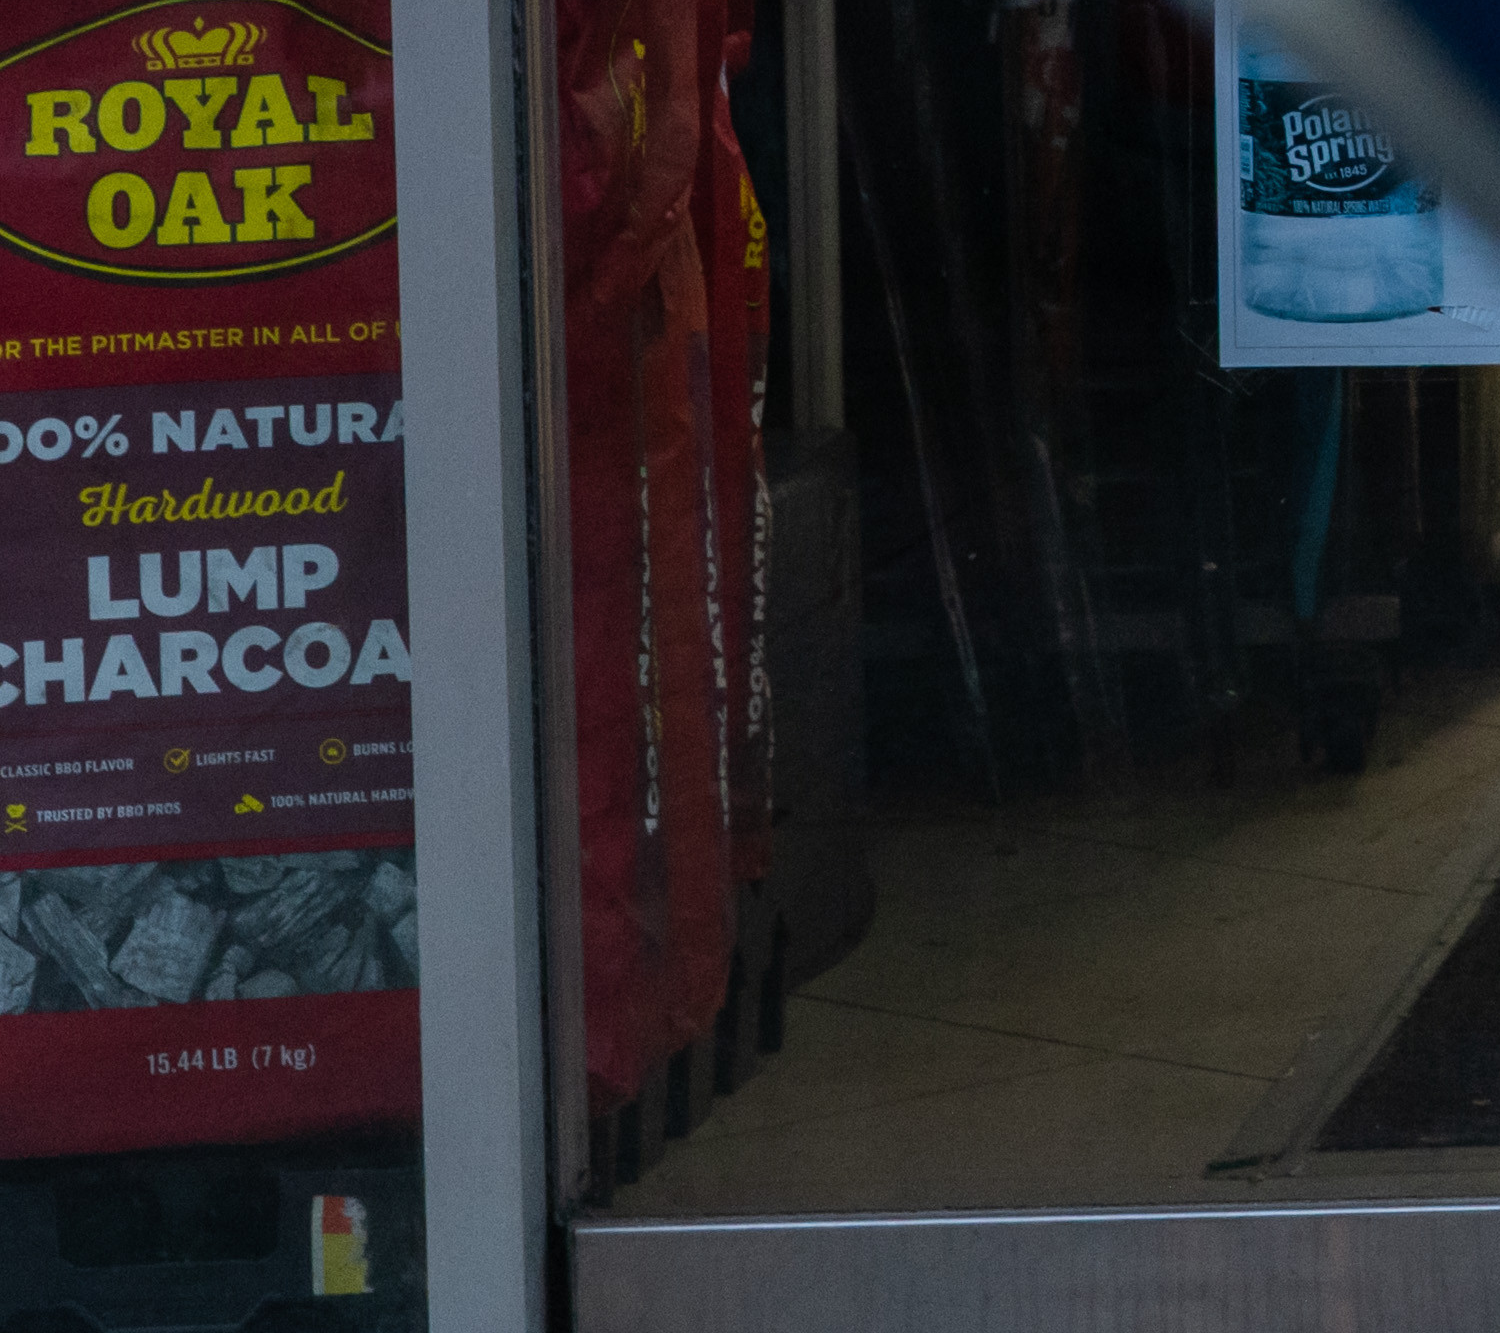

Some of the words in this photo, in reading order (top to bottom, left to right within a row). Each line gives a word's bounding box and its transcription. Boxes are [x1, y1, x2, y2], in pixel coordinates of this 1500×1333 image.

[24, 73, 375, 156] ROYAL
[1288, 133, 1394, 184] Spring
[87, 165, 315, 250] OAK
[30, 336, 82, 356] THE
[92, 329, 244, 354] PITMASTER
[253, 328, 280, 344] IN
[290, 325, 340, 343] ALL
[348, 322, 386, 341] OF
[79, 471, 346, 527] Hardwood
[88, 544, 339, 620] LUMP
[196, 751, 241, 766] LIGHTS
[245, 749, 275, 763] FAST
[37, 808, 94, 823] TRUSTED
[97, 806, 114, 819] BY
[117, 805, 144, 819] BBQ
[148, 803, 181, 816] PROS
[146, 1050, 205, 1074] 15.44
[212, 1048, 238, 1070] LB
[252, 1045, 270, 1070] (7
[280, 1044, 316, 1070] kg)
